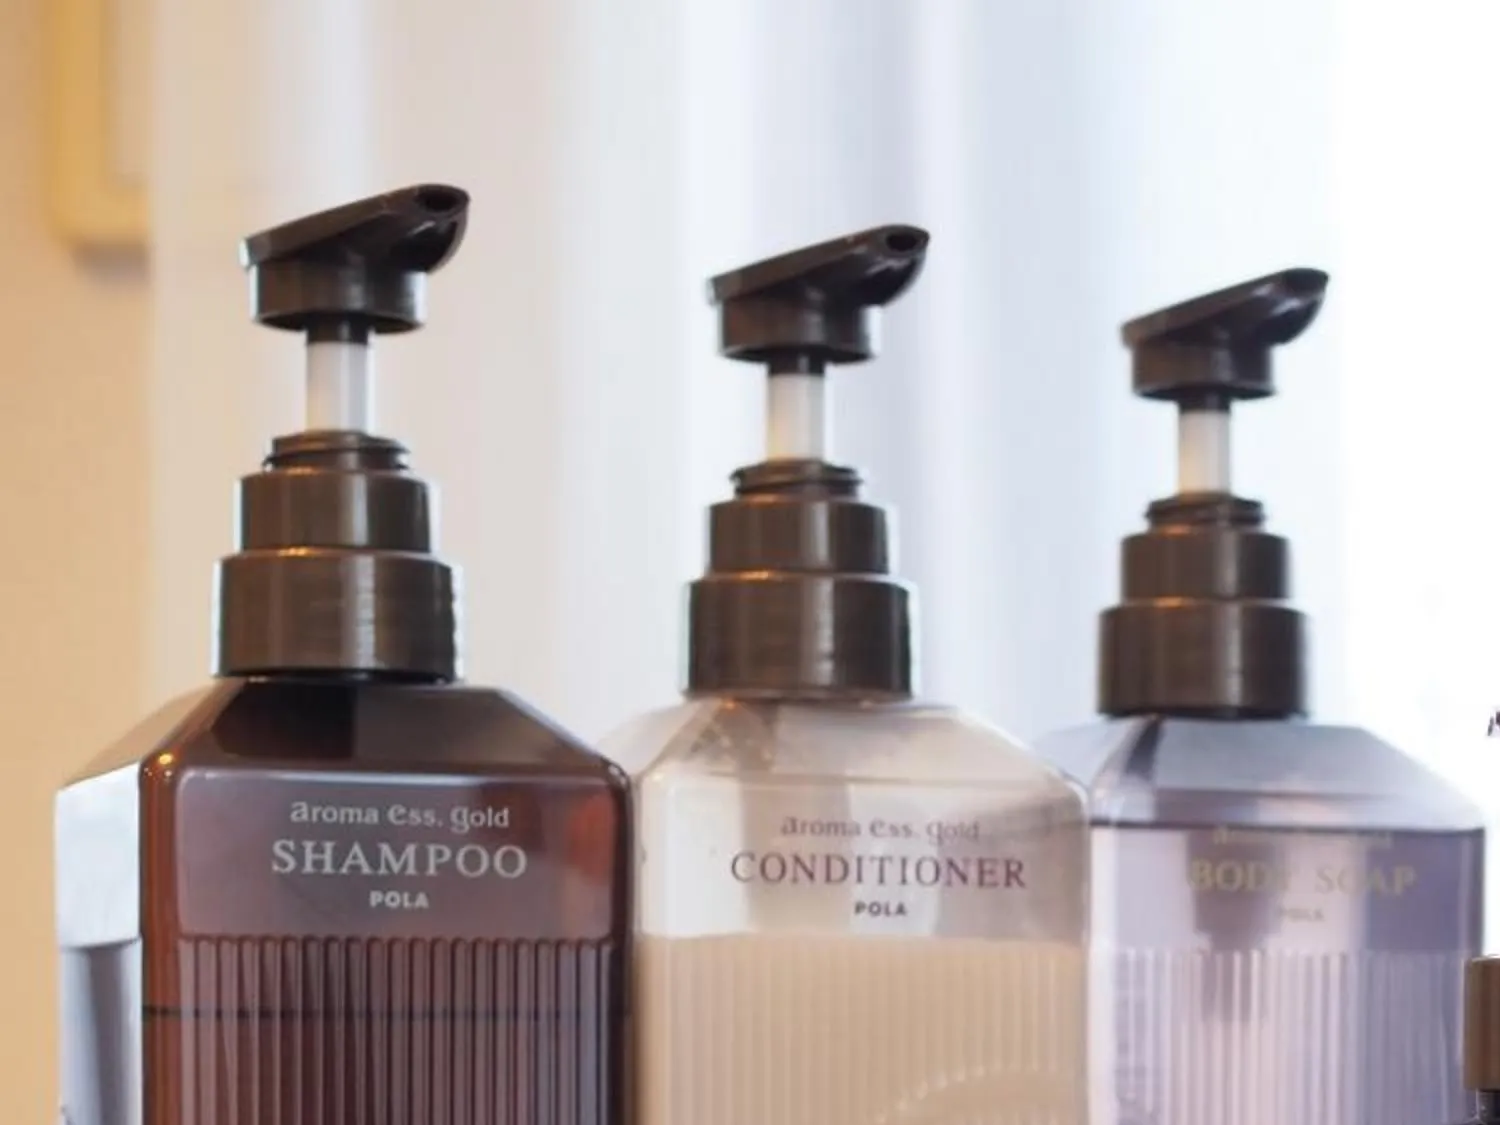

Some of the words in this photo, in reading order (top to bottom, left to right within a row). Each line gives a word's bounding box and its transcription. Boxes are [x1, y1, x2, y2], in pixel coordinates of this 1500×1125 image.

[290, 801, 379, 825] aroma
[388, 803, 443, 827] ess.
[450, 805, 510, 834] gold
[781, 816, 861, 838] aroma
[926, 820, 980, 846] gold
[272, 839, 527, 879] SHAMPOO
[731, 851, 1027, 889] CONDITIONER
[369, 889, 429, 909] POLA
[853, 900, 909, 918] POLA
